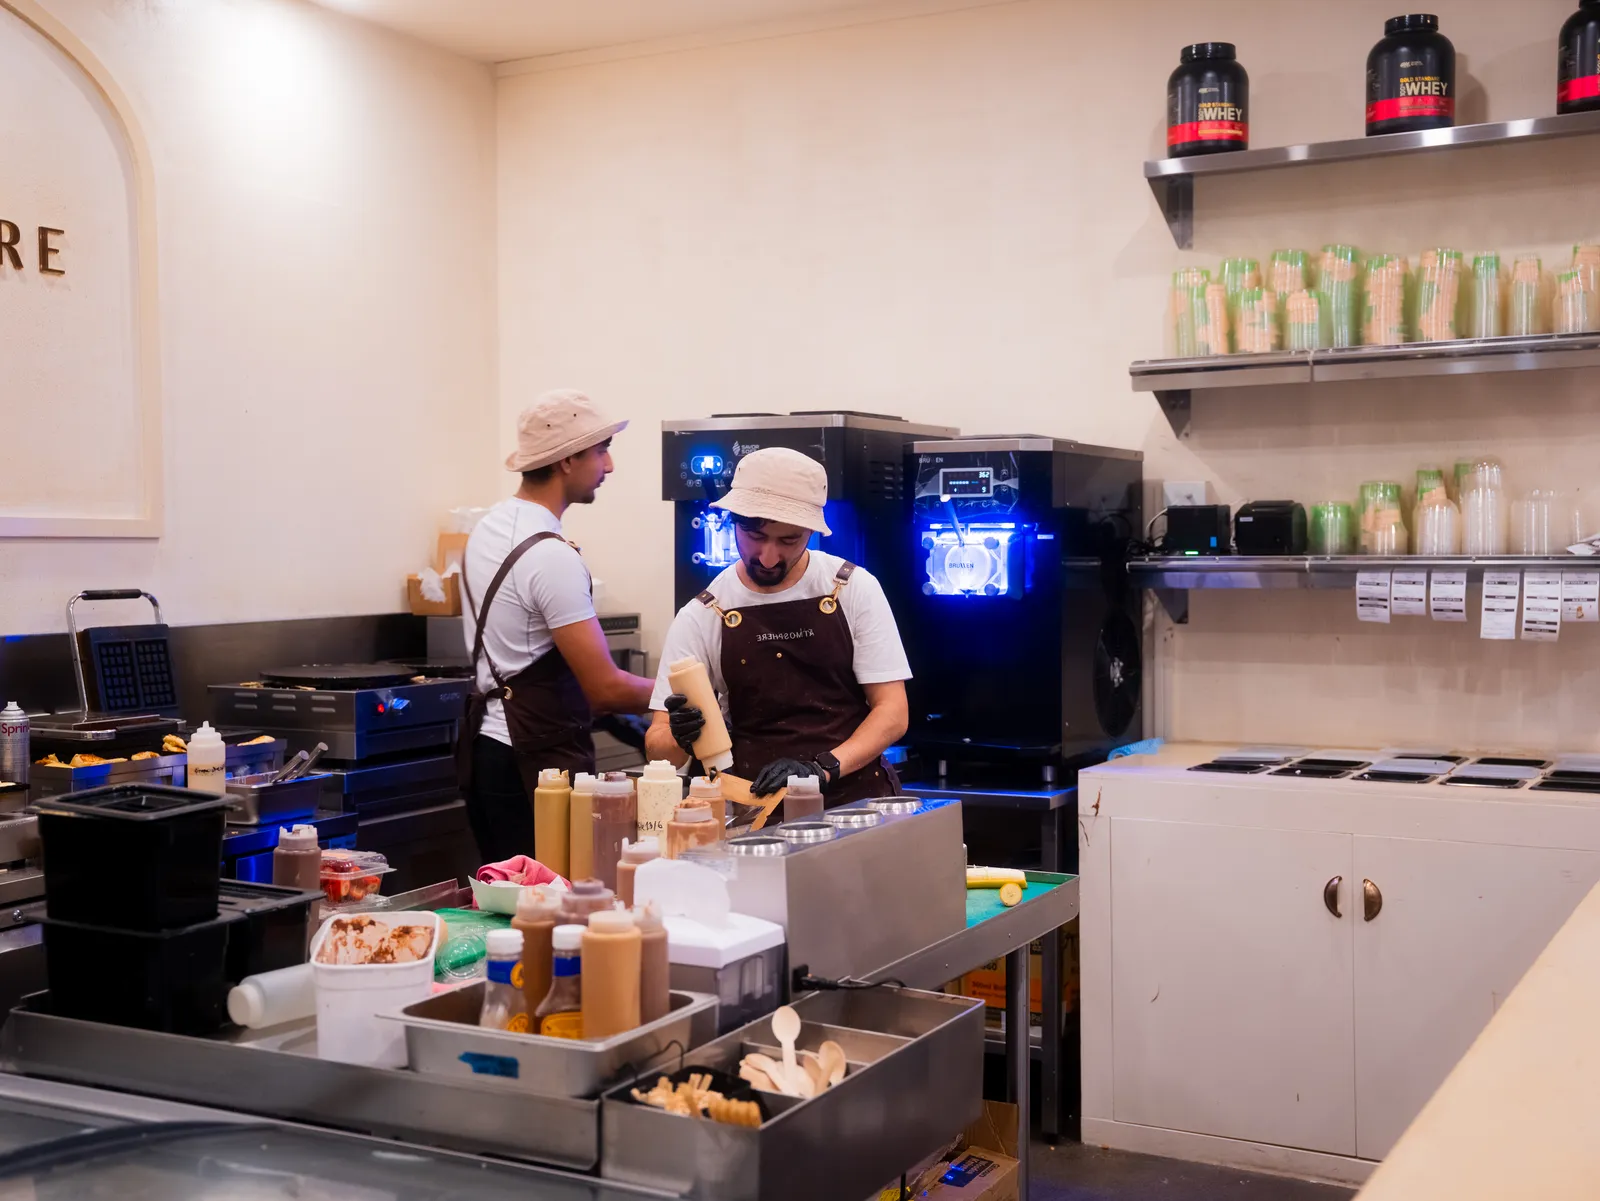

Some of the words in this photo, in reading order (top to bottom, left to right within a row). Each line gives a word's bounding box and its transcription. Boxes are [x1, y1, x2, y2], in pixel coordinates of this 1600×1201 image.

[1405, 81, 1448, 96] WHEY
[1204, 107, 1243, 121] WHEY
[0, 218, 66, 276] RE
